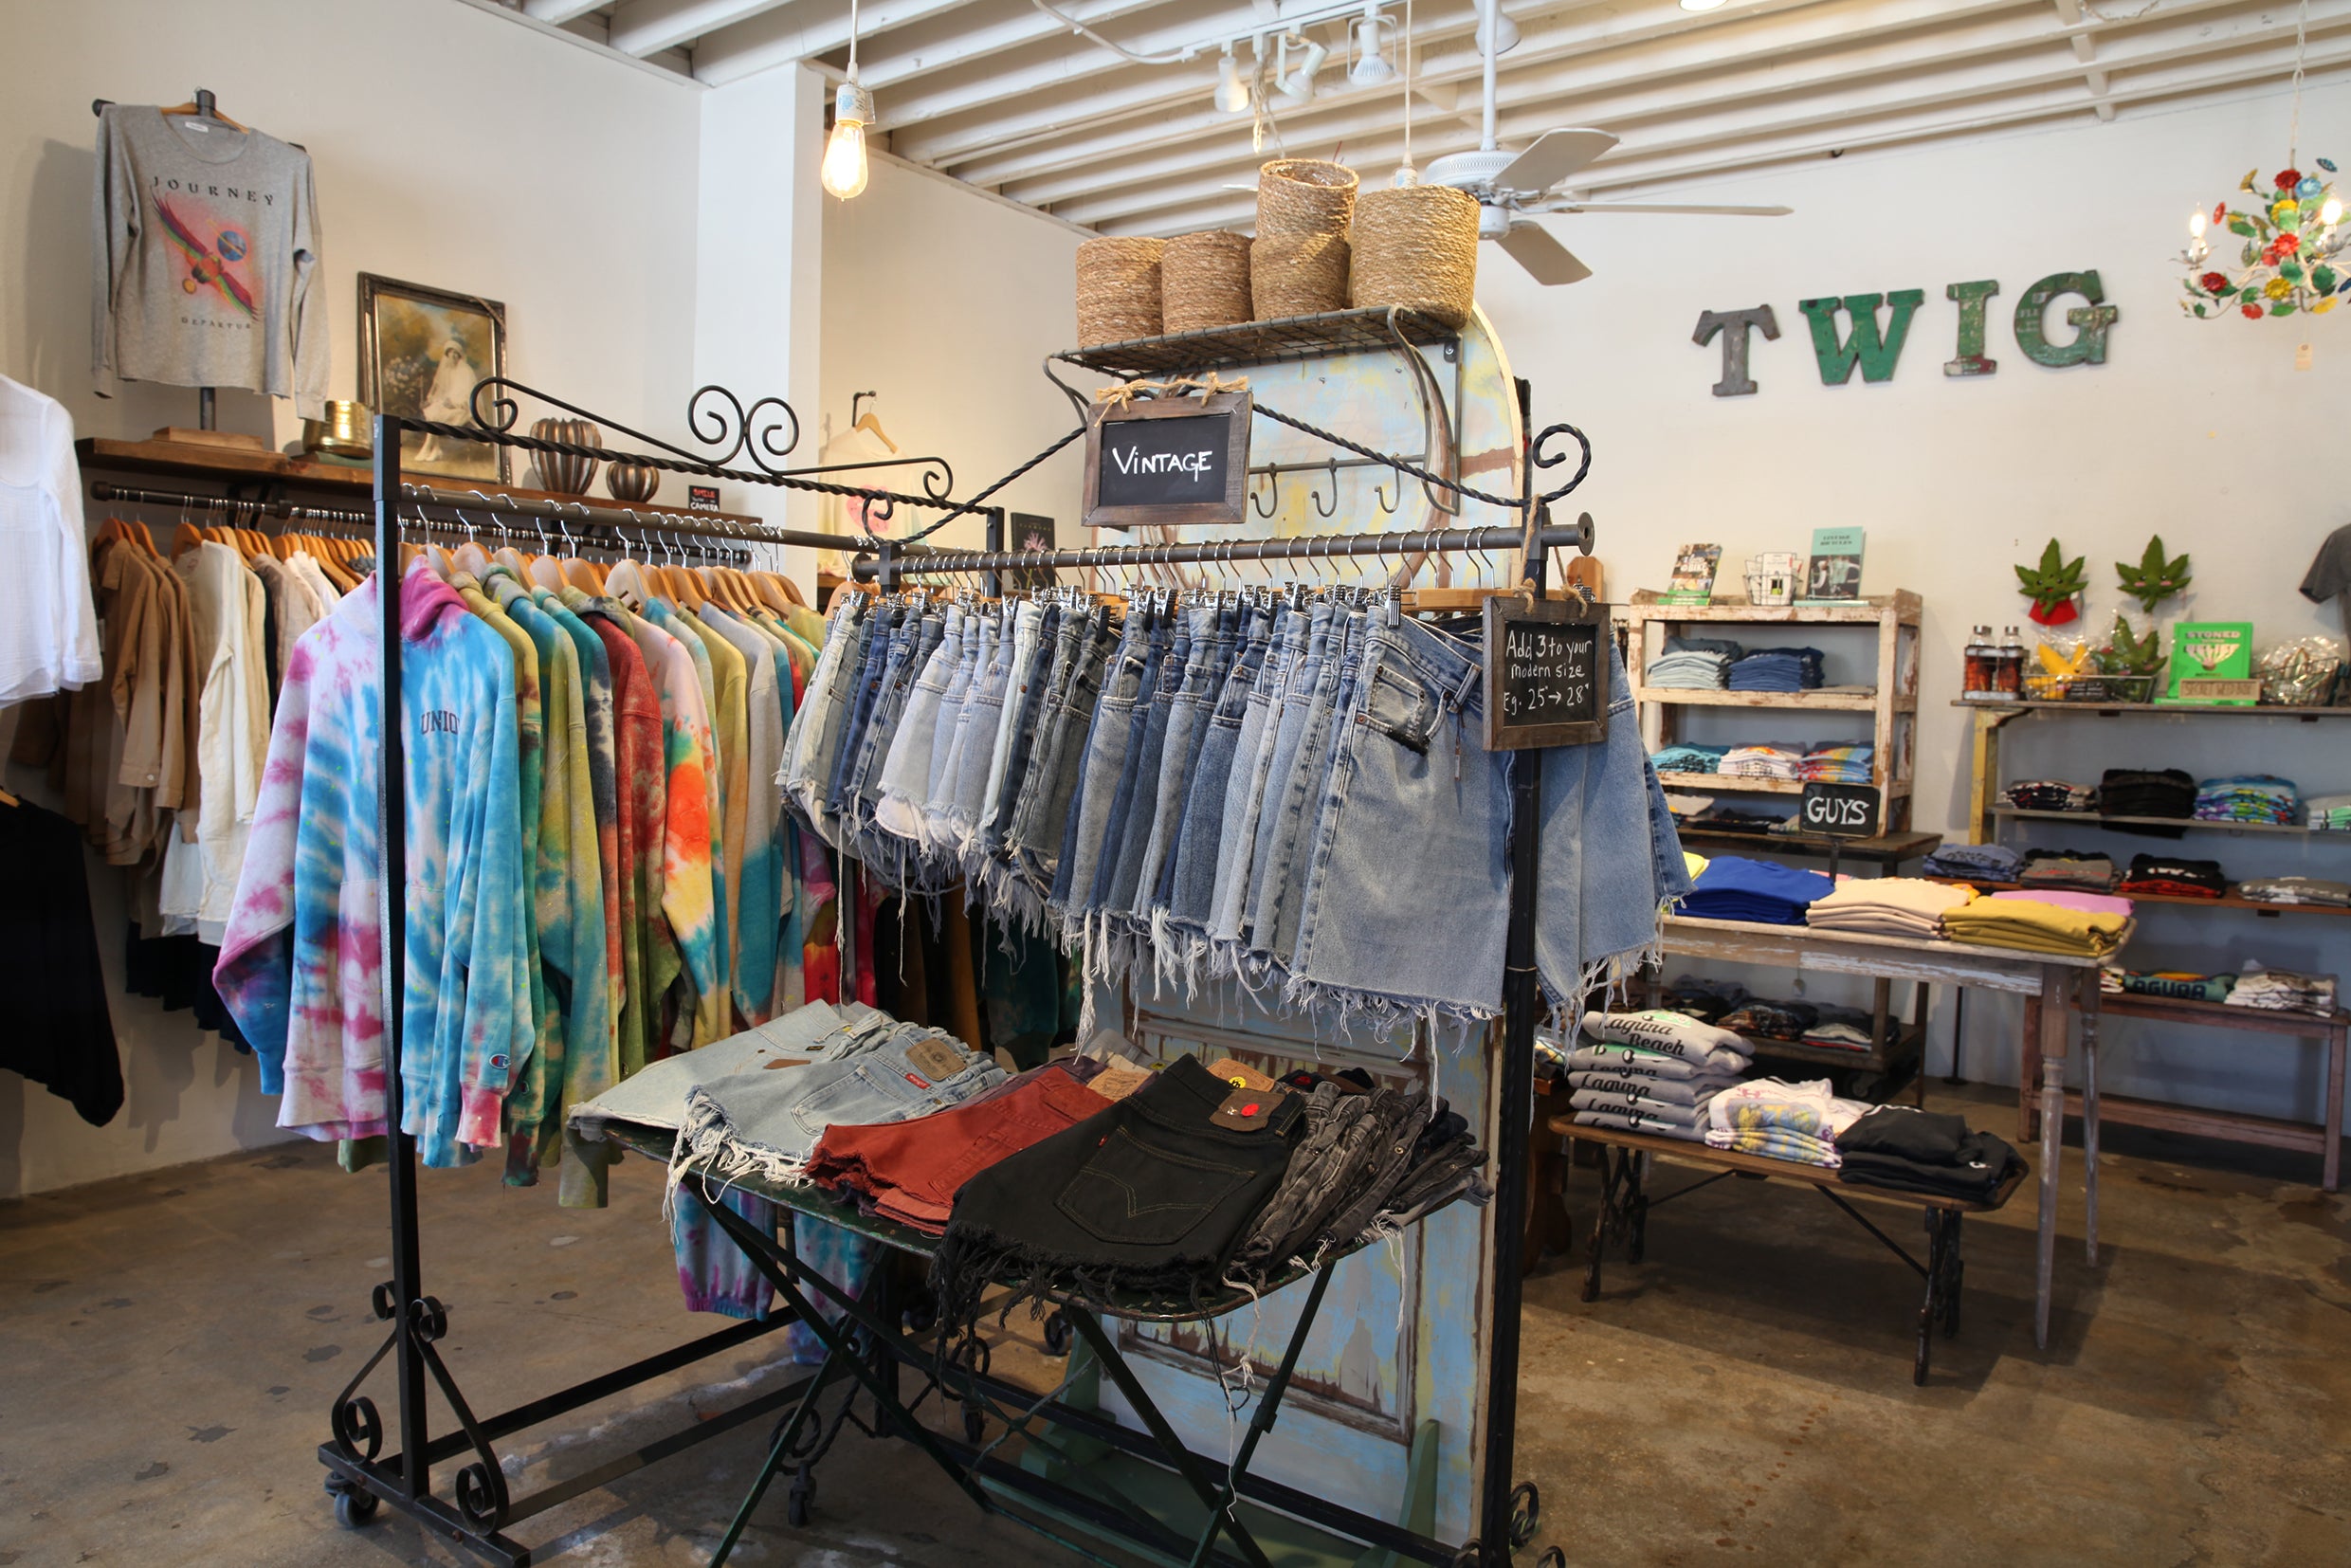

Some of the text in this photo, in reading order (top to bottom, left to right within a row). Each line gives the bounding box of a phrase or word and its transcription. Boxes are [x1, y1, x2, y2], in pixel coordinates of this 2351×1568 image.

[153, 175, 275, 206] JOURNEY
[181, 317, 252, 329] DEPARTUR
[1692, 269, 2118, 397] TWIG
[690, 501, 720, 512] CAMERA
[1505, 629, 1593, 664] Add 3 to your
[1556, 663, 1585, 679] size
[1504, 691, 1522, 716] Eg.
[421, 710, 460, 735] UNIO
[1807, 796, 1870, 825] GUYS
[1629, 1033, 1685, 1056] Beach
